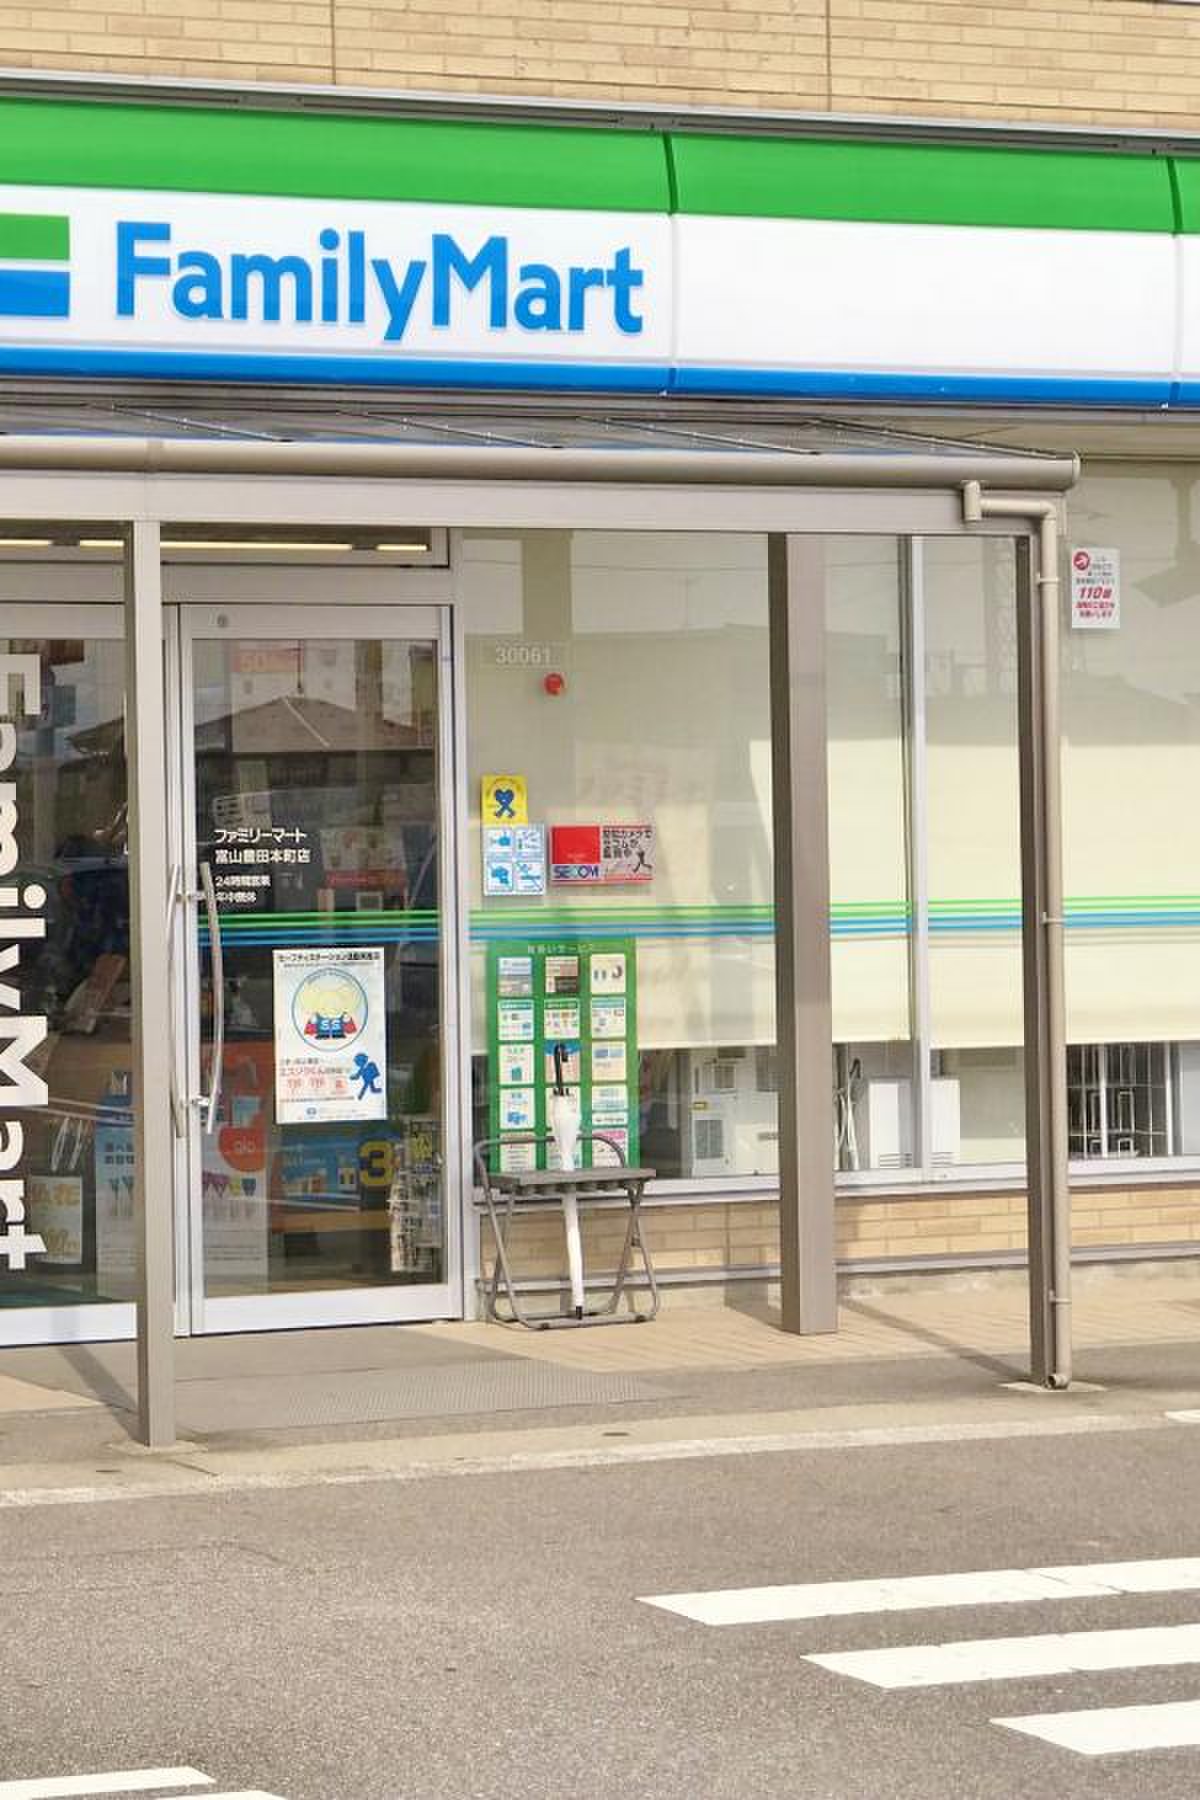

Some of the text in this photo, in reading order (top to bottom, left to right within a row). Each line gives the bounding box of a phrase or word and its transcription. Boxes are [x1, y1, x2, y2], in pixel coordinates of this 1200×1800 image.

[115, 220, 644, 341] FamilyMart
[495, 646, 551, 665] 30061
[213, 827, 308, 844] ファミリーマート
[553, 864, 599, 879] SECOM
